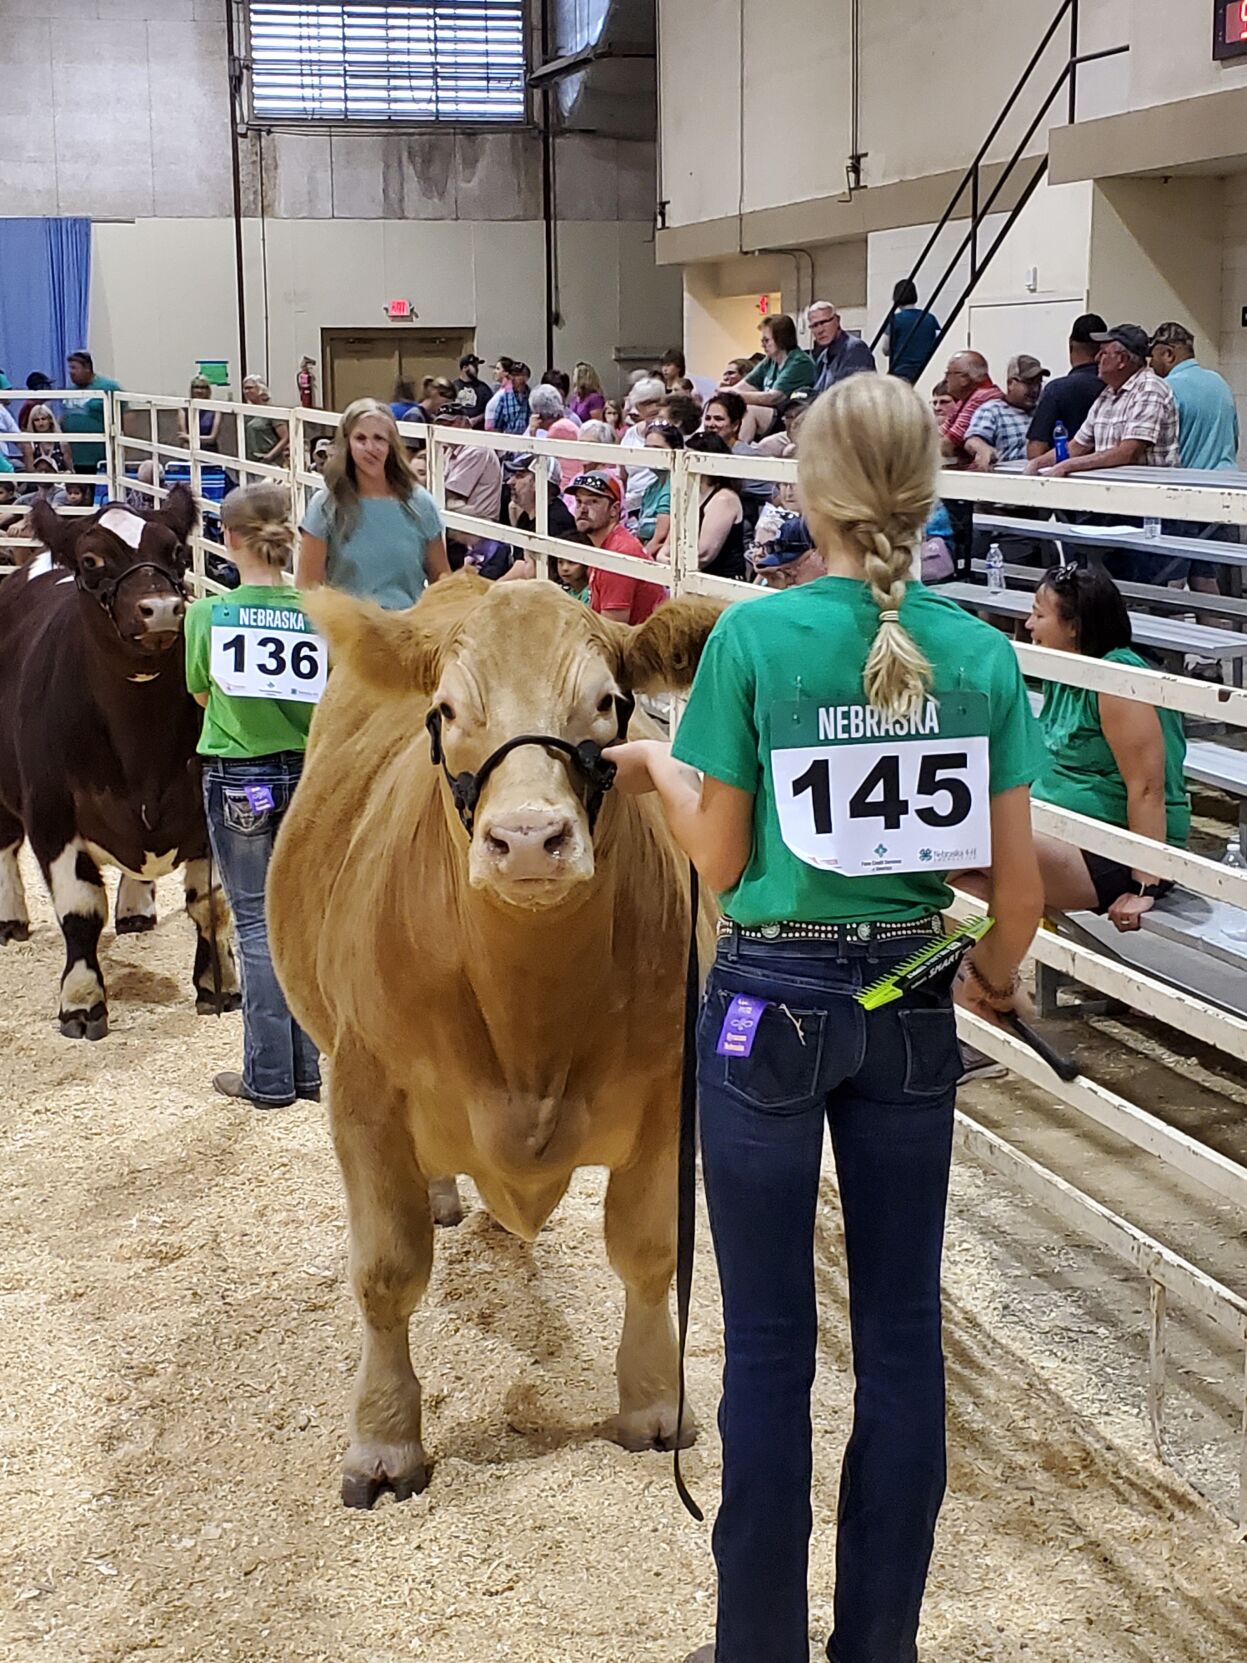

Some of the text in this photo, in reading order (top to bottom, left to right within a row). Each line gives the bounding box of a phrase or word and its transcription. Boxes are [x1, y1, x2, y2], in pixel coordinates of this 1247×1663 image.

[239, 608, 304, 630] NEBRASKA
[222, 634, 319, 680] 136
[792, 752, 972, 834] 145
